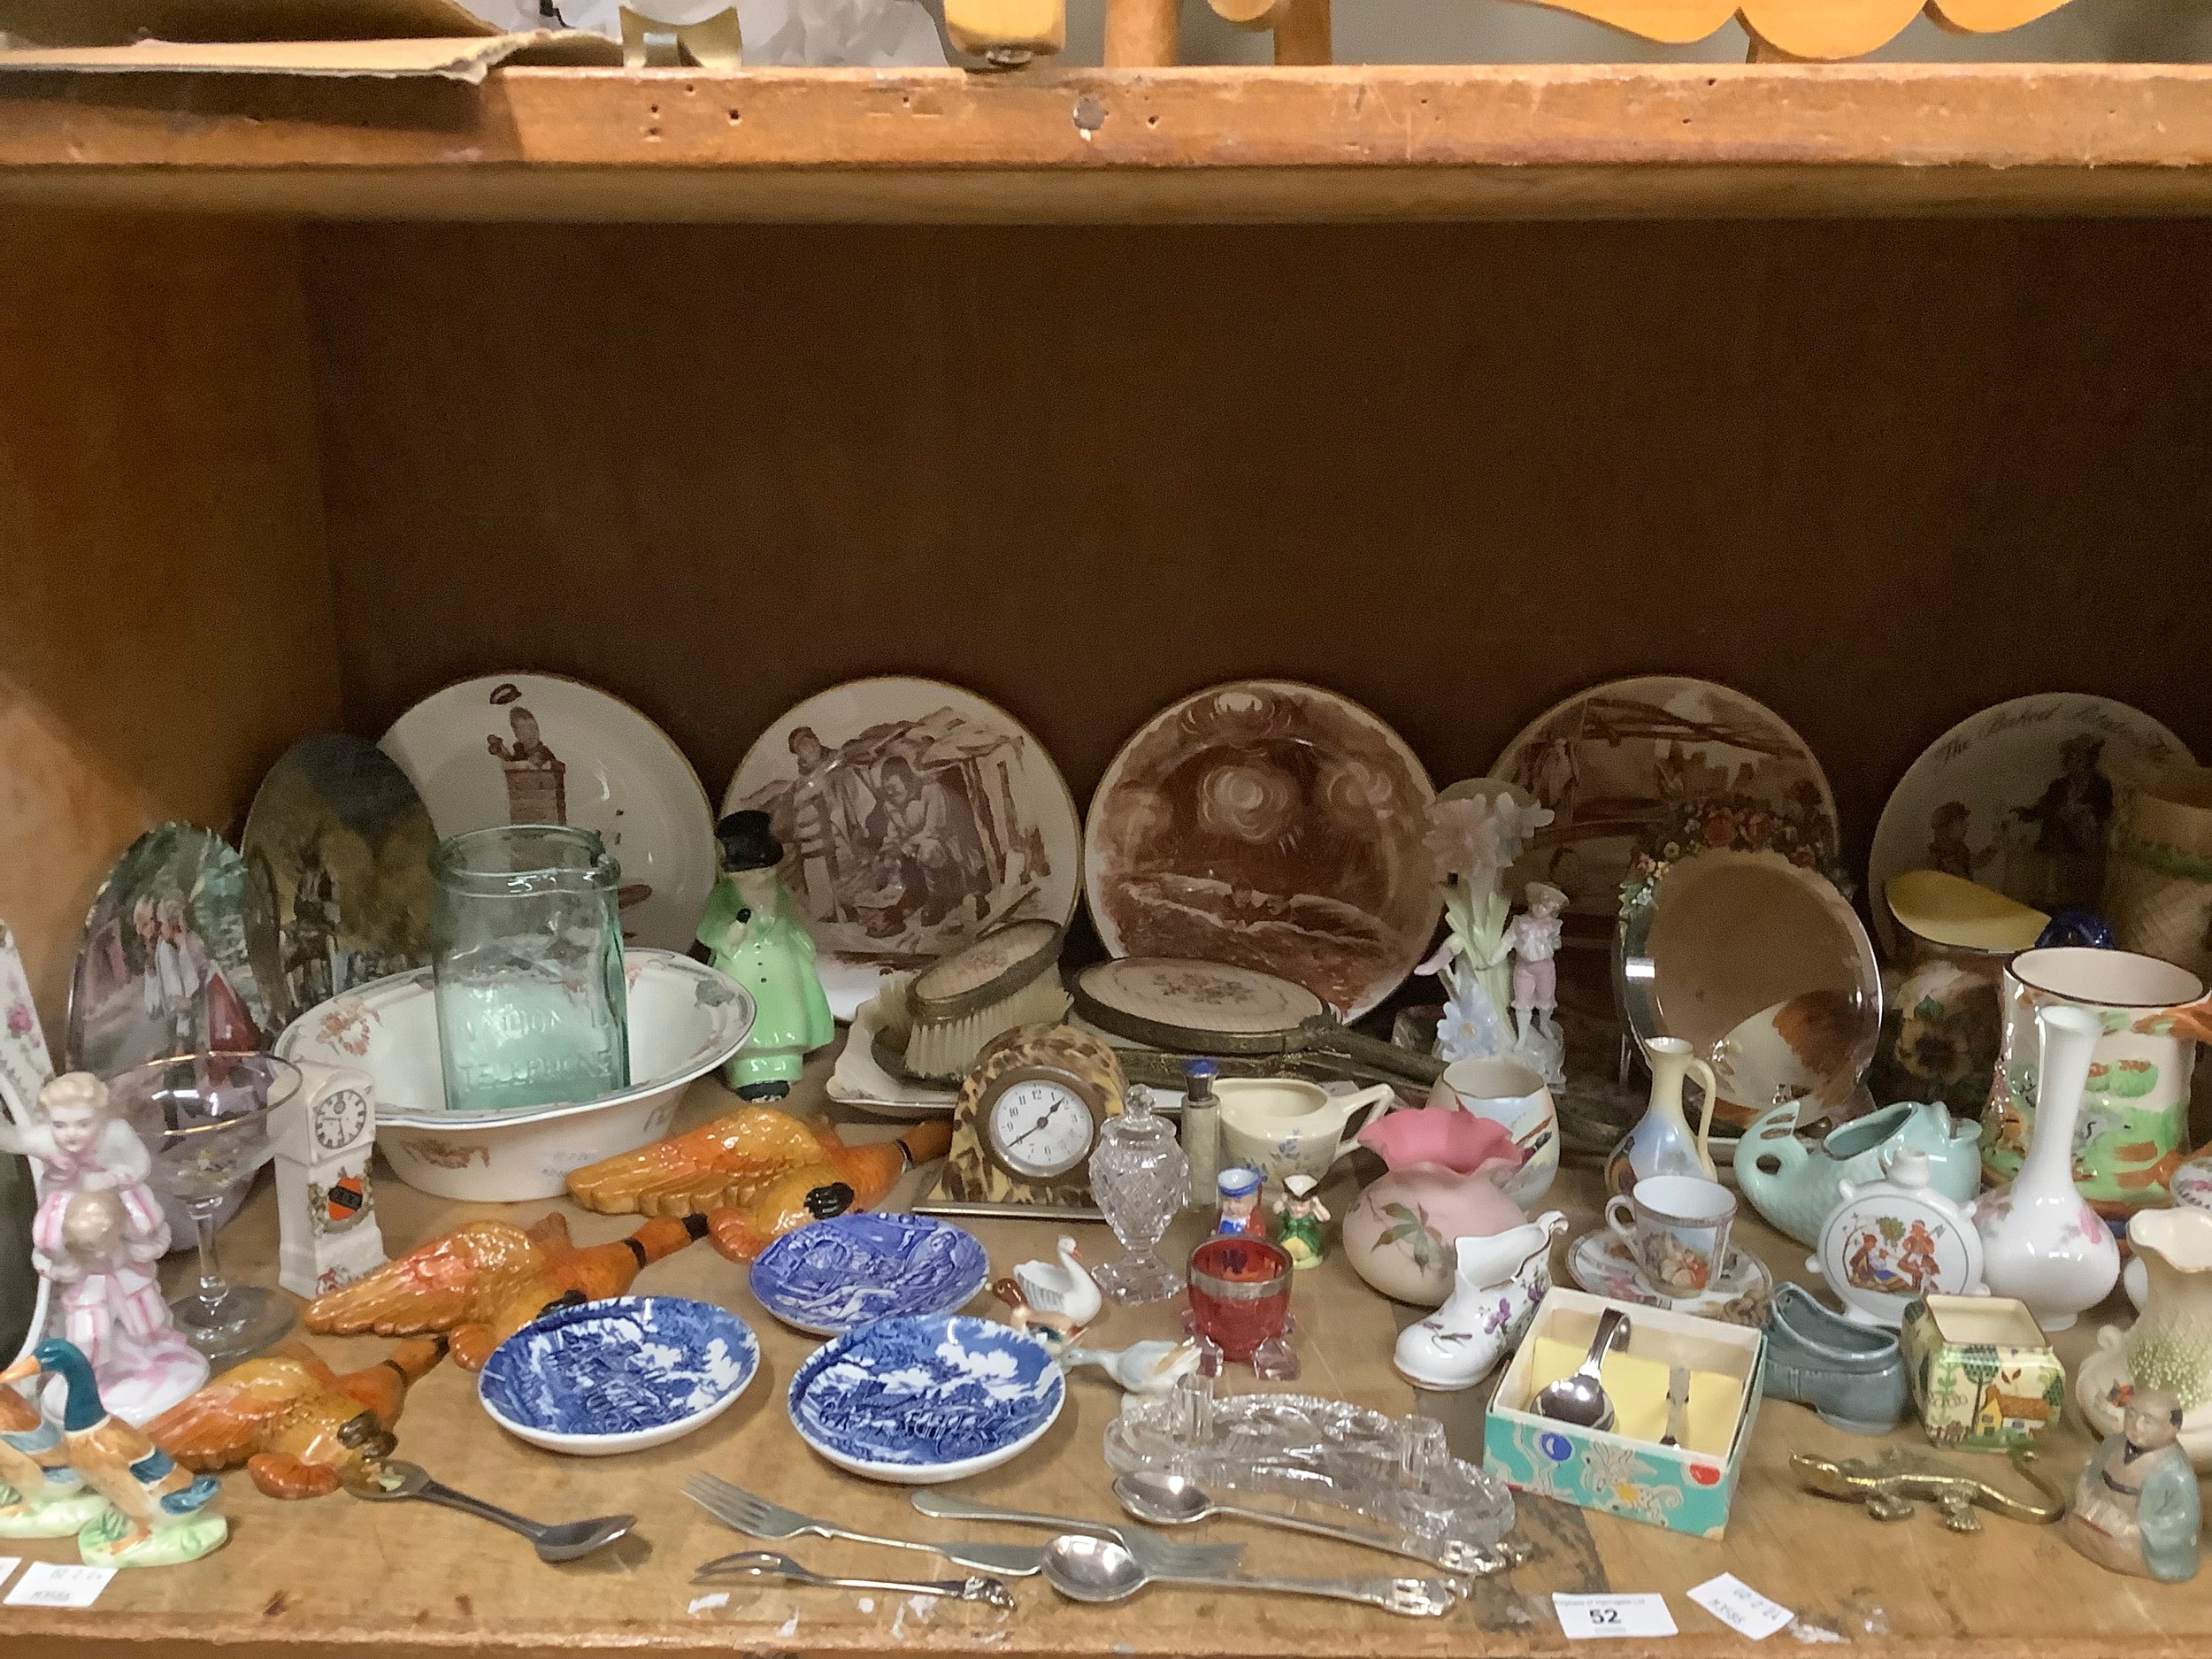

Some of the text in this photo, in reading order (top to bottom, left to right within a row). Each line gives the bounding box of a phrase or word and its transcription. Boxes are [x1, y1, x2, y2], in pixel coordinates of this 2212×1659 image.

[1018, 1094, 1026, 1106] 11
[1032, 1088, 1041, 1100] 12
[1010, 1107, 1019, 1118] 10
[1589, 1608, 1622, 1624] 52
